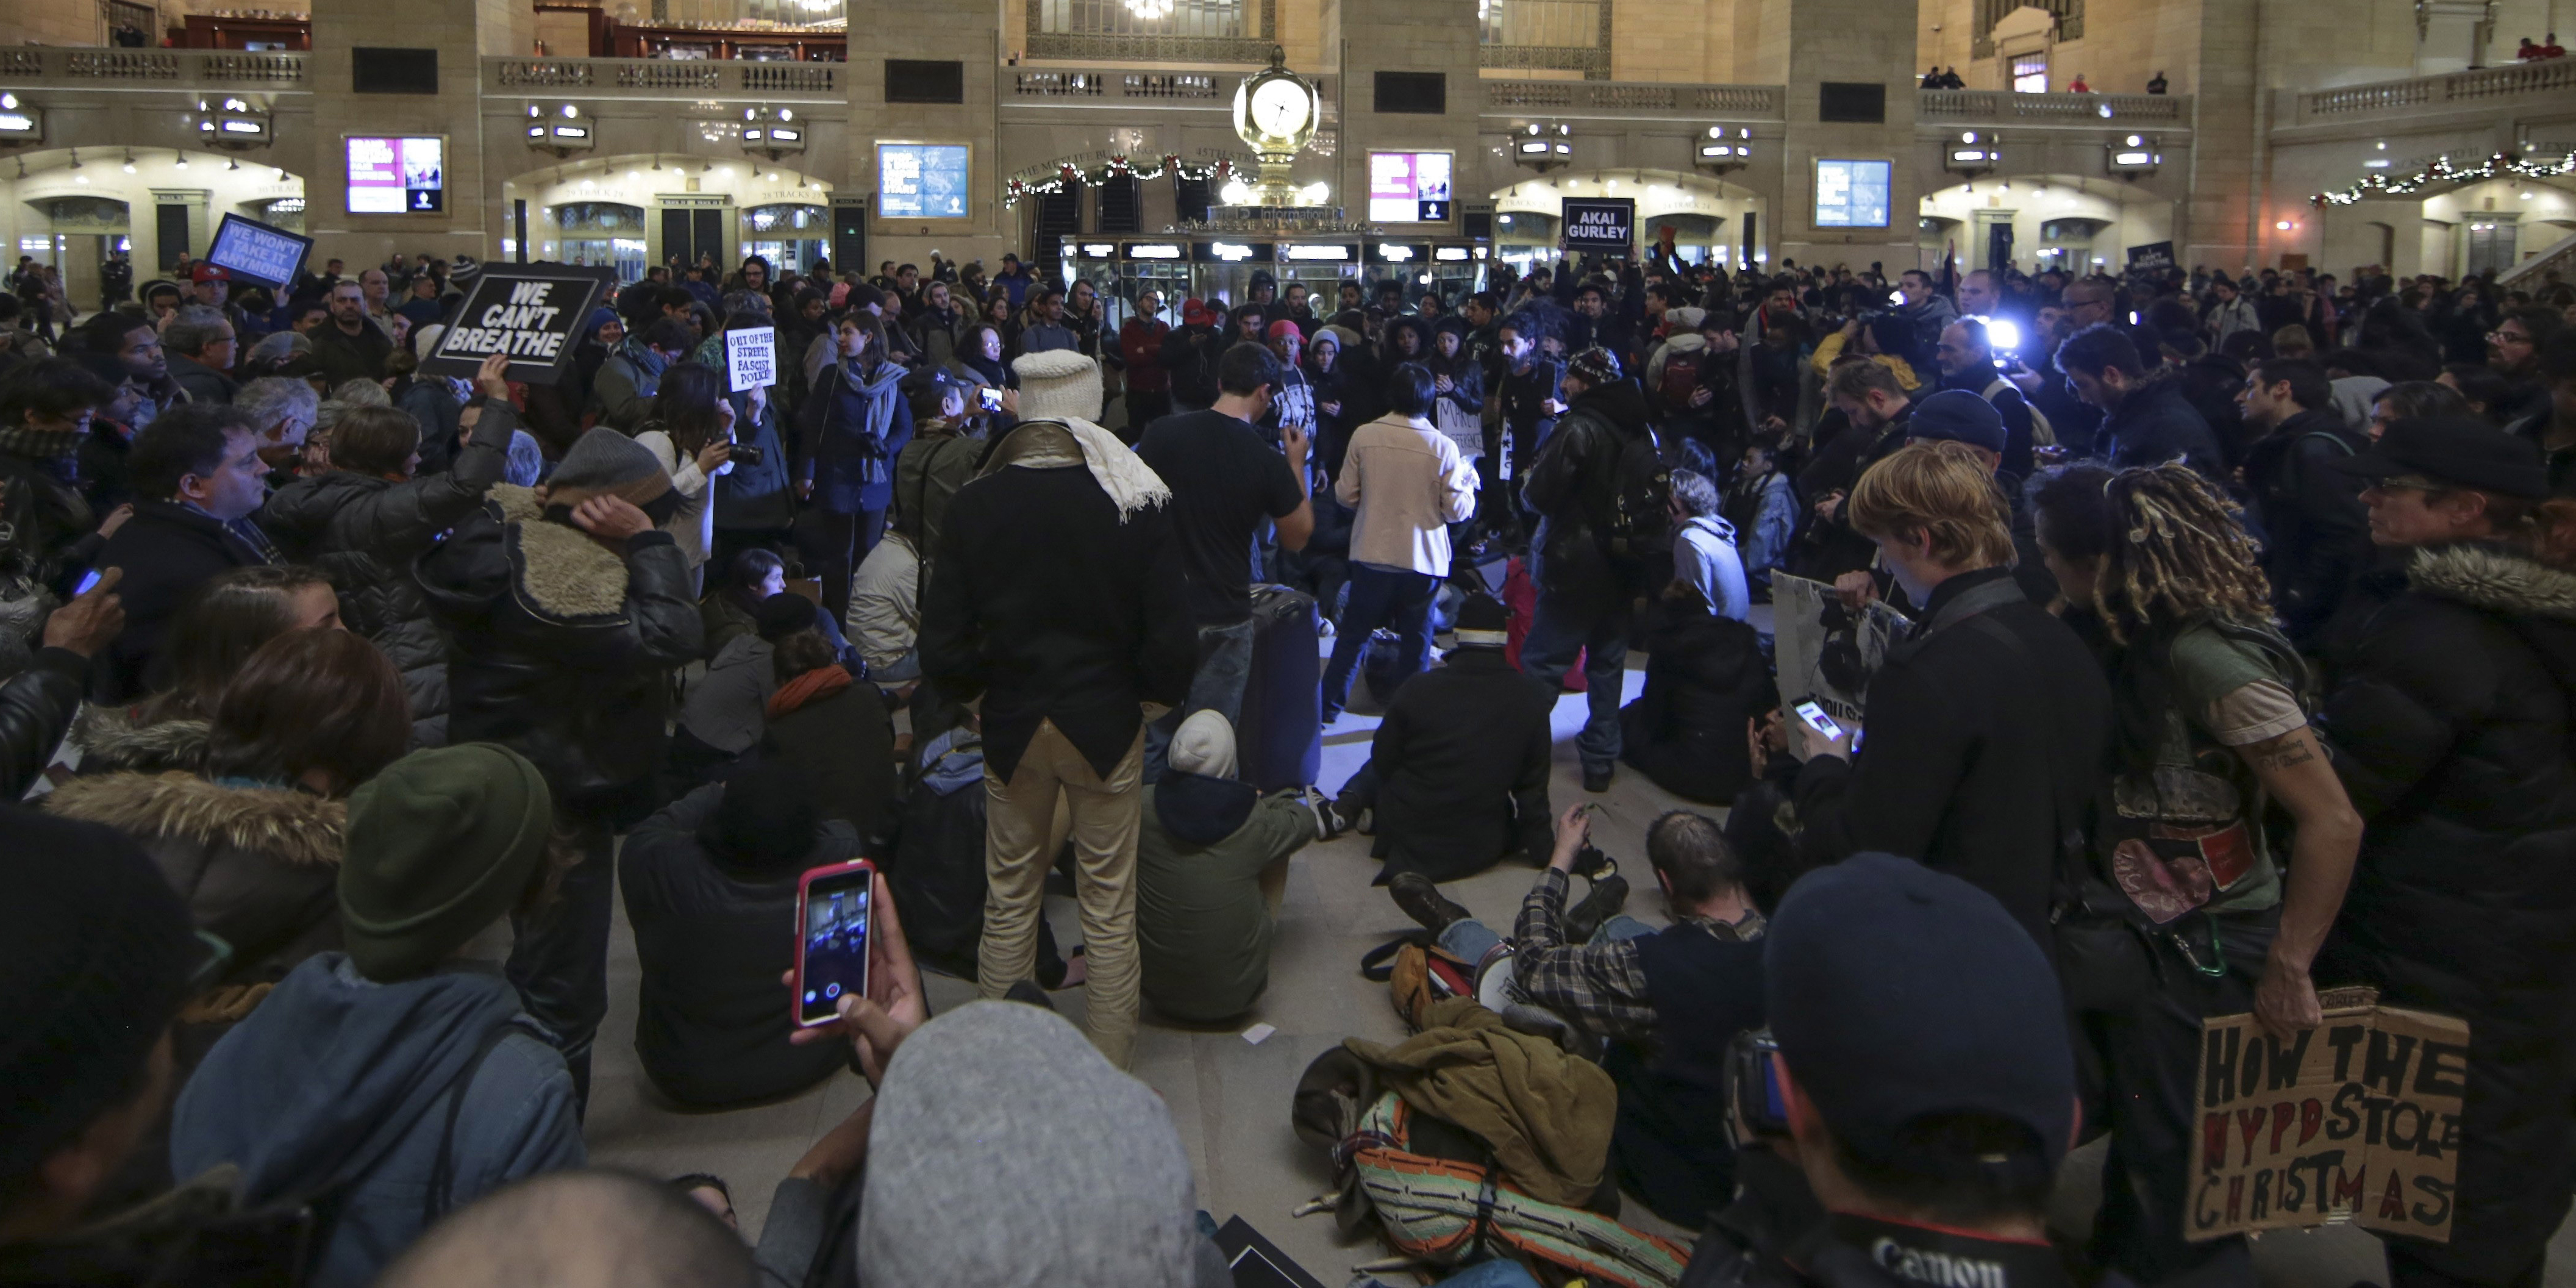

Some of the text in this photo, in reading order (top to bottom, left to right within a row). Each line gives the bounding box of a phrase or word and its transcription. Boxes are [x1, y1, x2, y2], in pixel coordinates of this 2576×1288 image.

[1014, 164, 1040, 178] THE
[1568, 224, 1627, 239] GURLEY
[1580, 212, 1615, 225] AKAI
[229, 224, 299, 255] WE WON'T
[233, 239, 287, 265] TAKE IT
[218, 250, 290, 281] ANYMORE
[510, 281, 554, 306] WE
[482, 304, 560, 331] CAN'T
[445, 327, 566, 357] BREATHE
[730, 332, 773, 346] OUT OF THE
[737, 346, 769, 357] STREETS
[738, 360, 769, 371] FASCIST
[2205, 1025, 2467, 1107] HOW THE
[2202, 1082, 2462, 1175] NYPD STOLE
[1872, 1236, 2005, 1288] Canon
